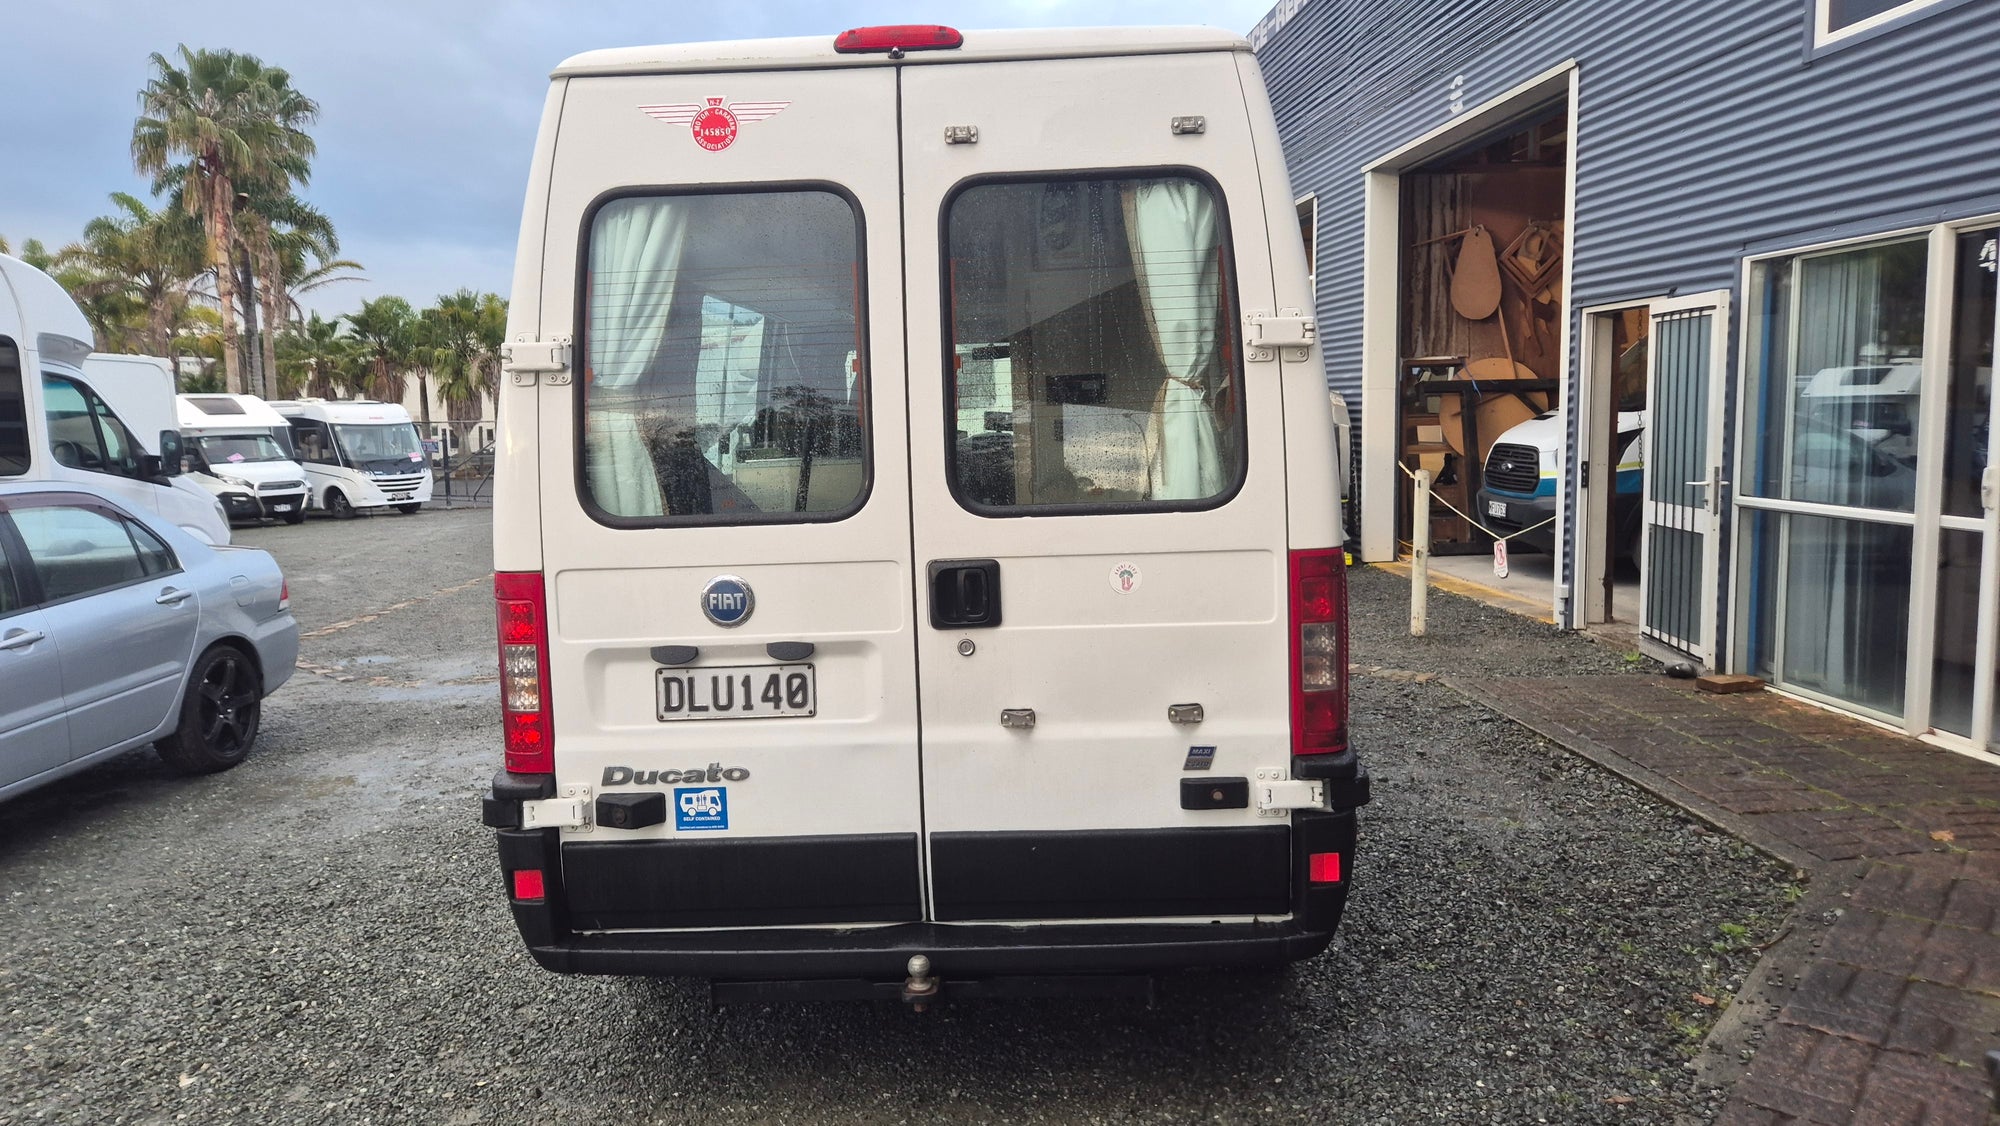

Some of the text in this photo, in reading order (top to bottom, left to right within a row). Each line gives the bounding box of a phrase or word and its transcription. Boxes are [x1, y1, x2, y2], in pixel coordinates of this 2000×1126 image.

[694, 108, 736, 131] MOTOR CARAVAN
[696, 135, 734, 150] ASSOCIATION
[700, 127, 731, 137] 145850
[1978, 239, 1997, 272] 4
[709, 593, 744, 610] FIAT
[663, 673, 808, 712] DLU140
[601, 762, 750, 786] Ducato
